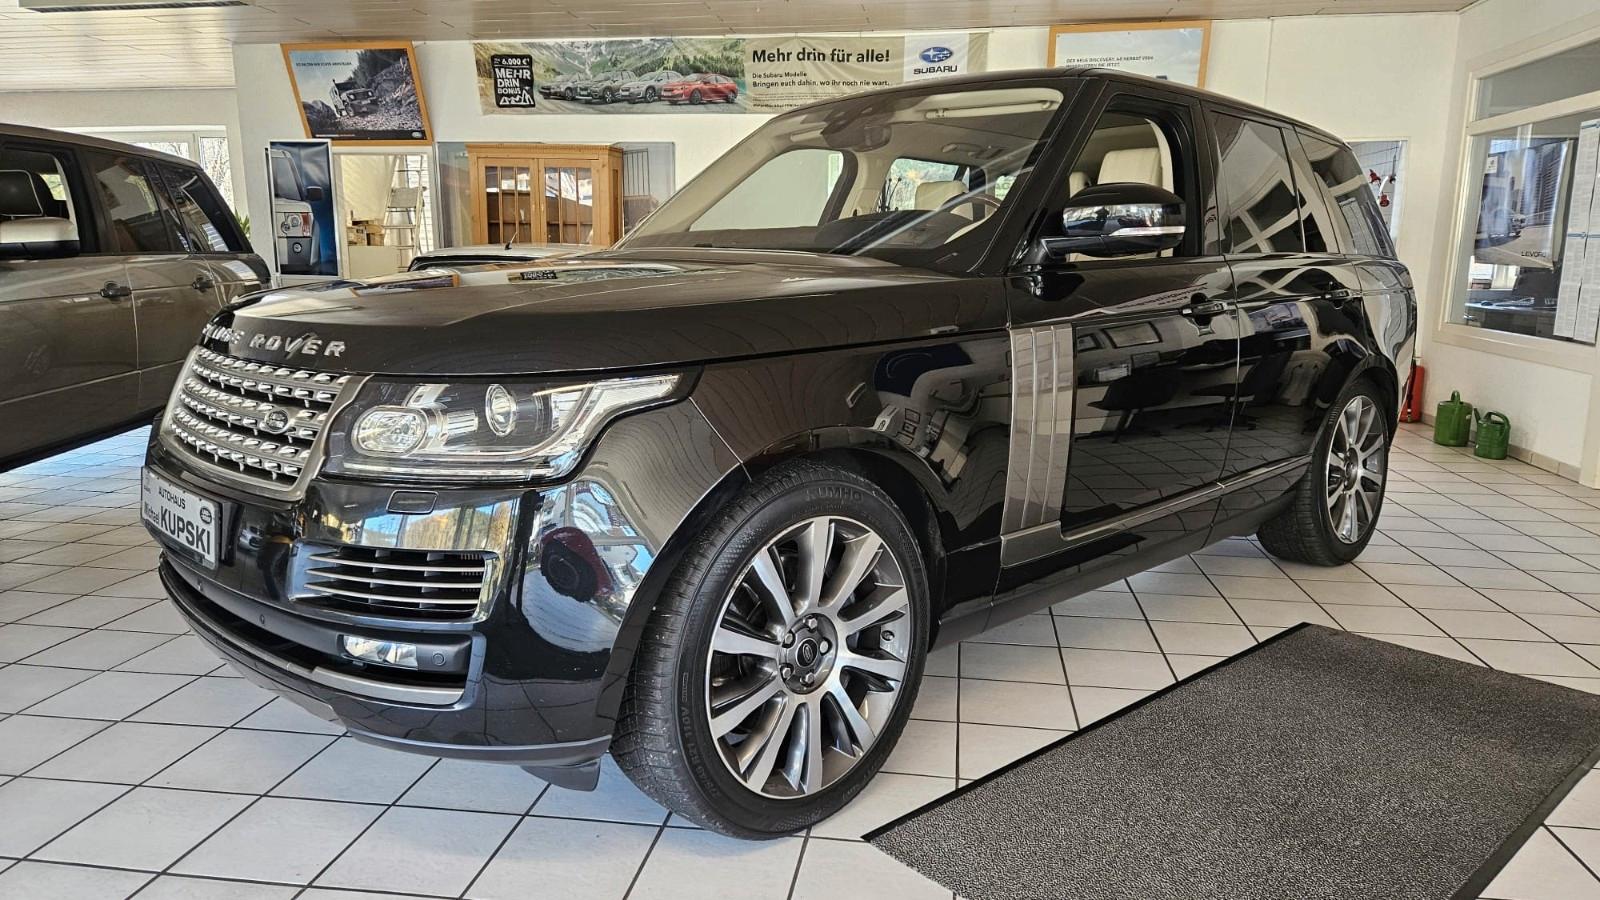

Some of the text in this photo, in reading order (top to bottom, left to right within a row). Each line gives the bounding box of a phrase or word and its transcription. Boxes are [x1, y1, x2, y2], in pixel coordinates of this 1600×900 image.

[752, 47, 890, 63] Mehr drin für alle!
[495, 67, 531, 80] MEHR
[913, 65, 958, 75] SUBARU
[497, 78, 520, 88] DRIN
[752, 80, 779, 89] Bringen
[780, 79, 796, 87] euch
[249, 332, 346, 357] ROVER
[158, 487, 186, 510] AUTOHAUS
[160, 505, 211, 556] KUPSKI
